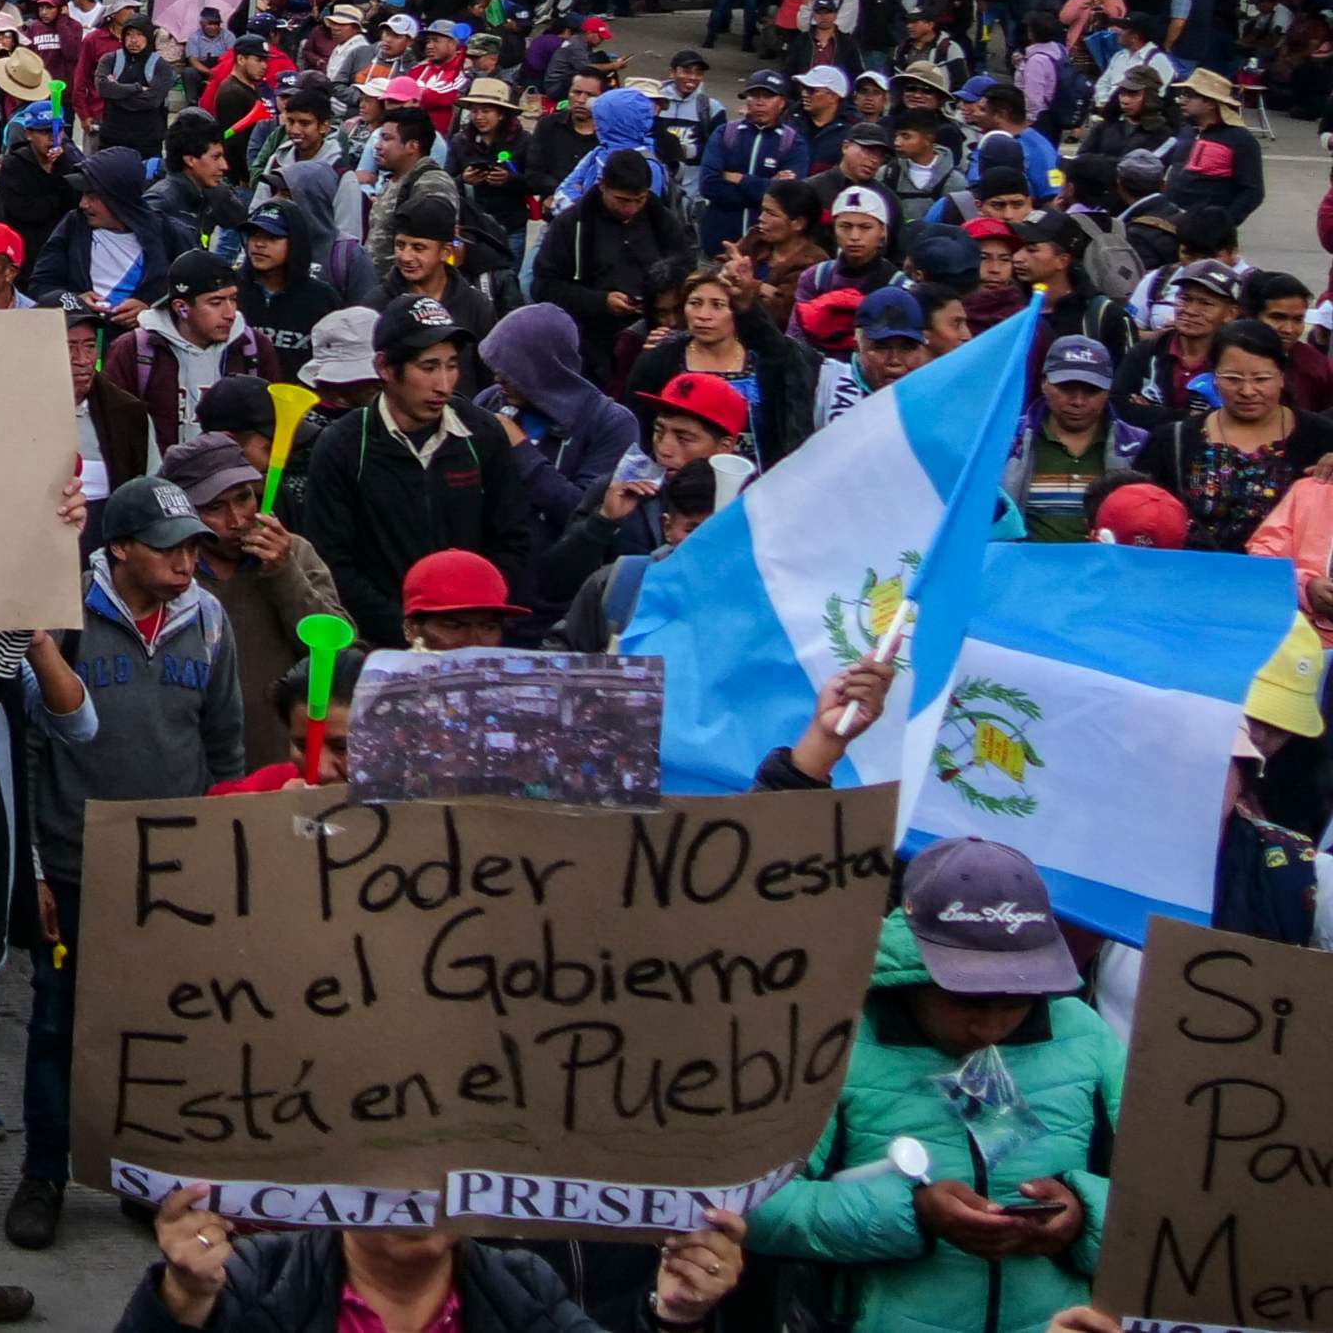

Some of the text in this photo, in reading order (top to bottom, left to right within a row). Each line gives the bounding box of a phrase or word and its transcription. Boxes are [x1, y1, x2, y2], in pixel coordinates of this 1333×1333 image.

[135, 801, 891, 926] El Poder NO esta
[938, 901, 985, 923] Ben
[167, 907, 808, 1021] en el Gobierno
[1178, 951, 1294, 1056] Si
[114, 1003, 851, 1145] Está en el Pueblo
